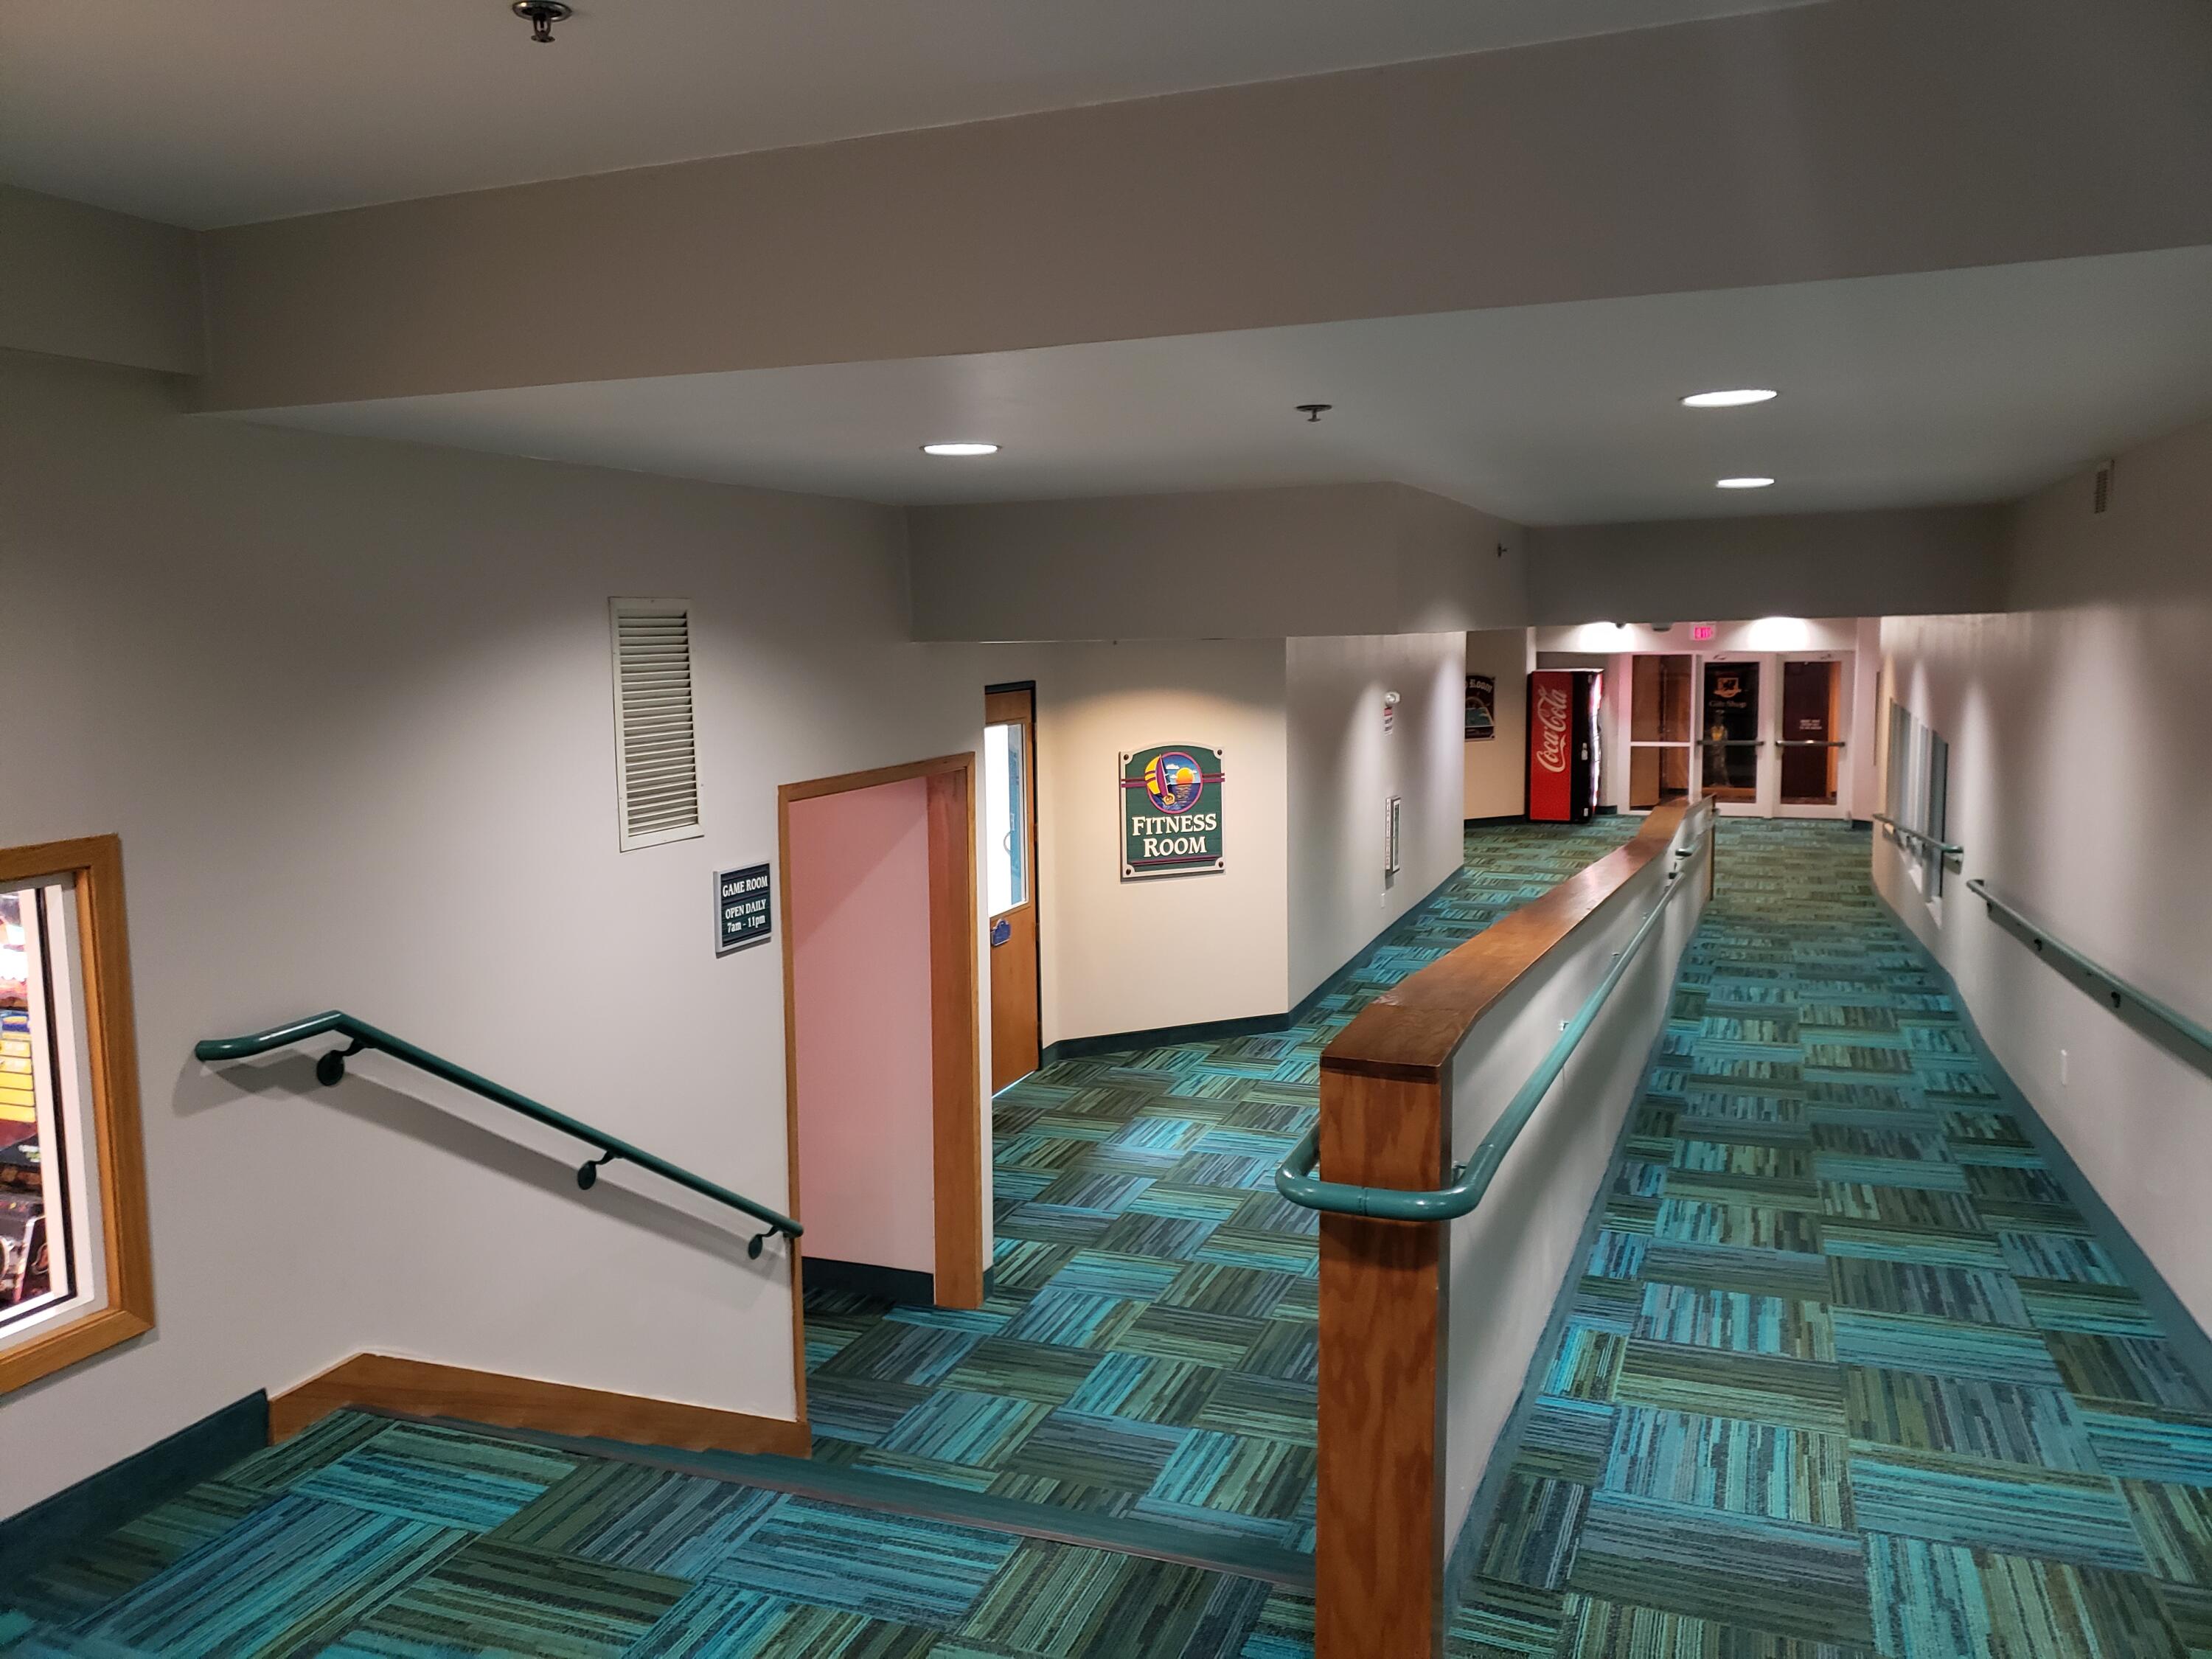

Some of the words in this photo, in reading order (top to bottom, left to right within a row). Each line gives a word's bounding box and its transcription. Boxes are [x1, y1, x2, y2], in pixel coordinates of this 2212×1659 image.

[1536, 684, 1568, 773] Coca-Cola
[1132, 813, 1217, 836] FITNESS
[1144, 836, 1207, 858] ROOM
[723, 880, 745, 897] GAME
[746, 875, 768, 892] ROOM
[725, 905, 745, 919] OPEN
[745, 899, 767, 914] DAILY
[727, 922, 742, 933] 7am
[748, 915, 766, 928] 11pm
